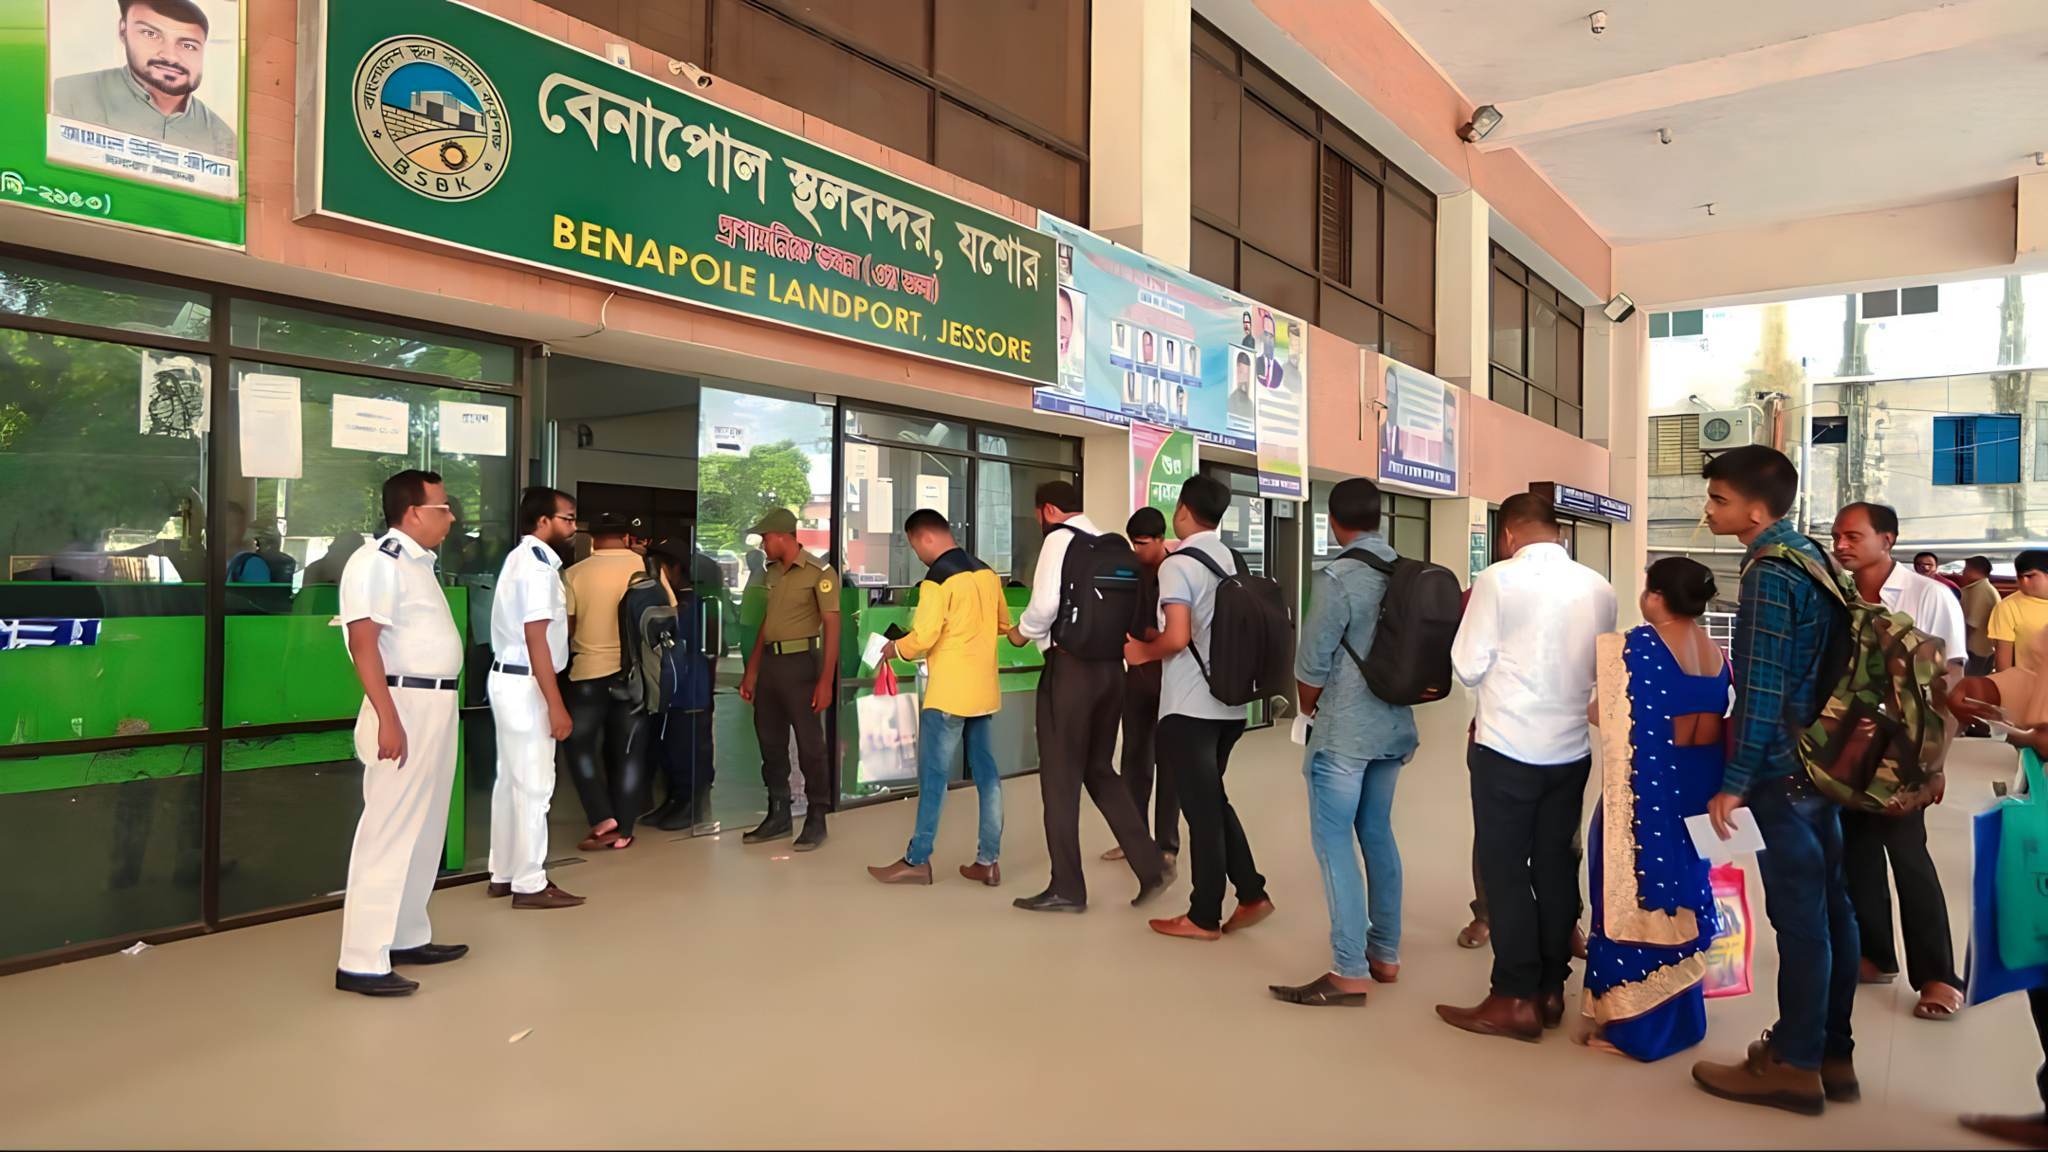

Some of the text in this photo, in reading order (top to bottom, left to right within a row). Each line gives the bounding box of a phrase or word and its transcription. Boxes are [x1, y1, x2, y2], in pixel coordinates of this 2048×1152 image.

[392, 157, 472, 192] BSBK
[538, 72, 1043, 292] বেনাপোল স্থলবন্দর, যশোর
[552, 213, 1033, 365] BENAPOLE LANDPORT, JESSORE
